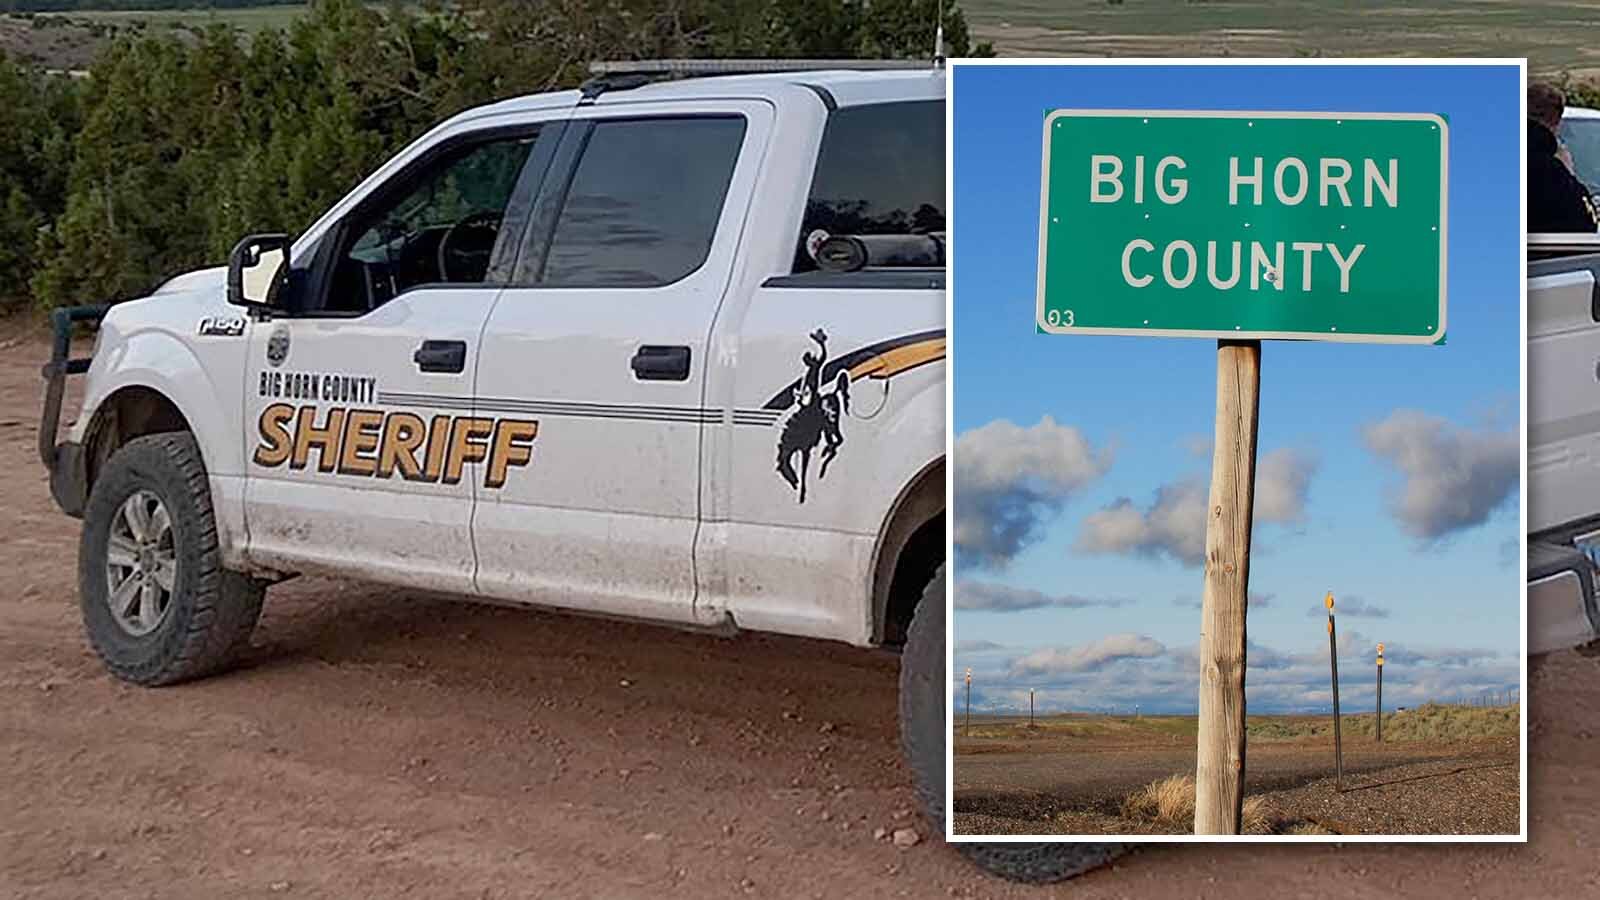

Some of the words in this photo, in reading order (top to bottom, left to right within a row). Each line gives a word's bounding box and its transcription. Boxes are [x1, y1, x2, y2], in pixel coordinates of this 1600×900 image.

[1090, 154, 1189, 204] BIG
[1228, 156, 1398, 208] HORN
[1121, 239, 1366, 293] COUNTY
[1048, 309, 1074, 327] 03
[259, 371, 281, 397] BIG
[284, 373, 320, 400] HORN
[322, 375, 376, 403] COUNTY
[253, 402, 539, 488] SHERIFF
